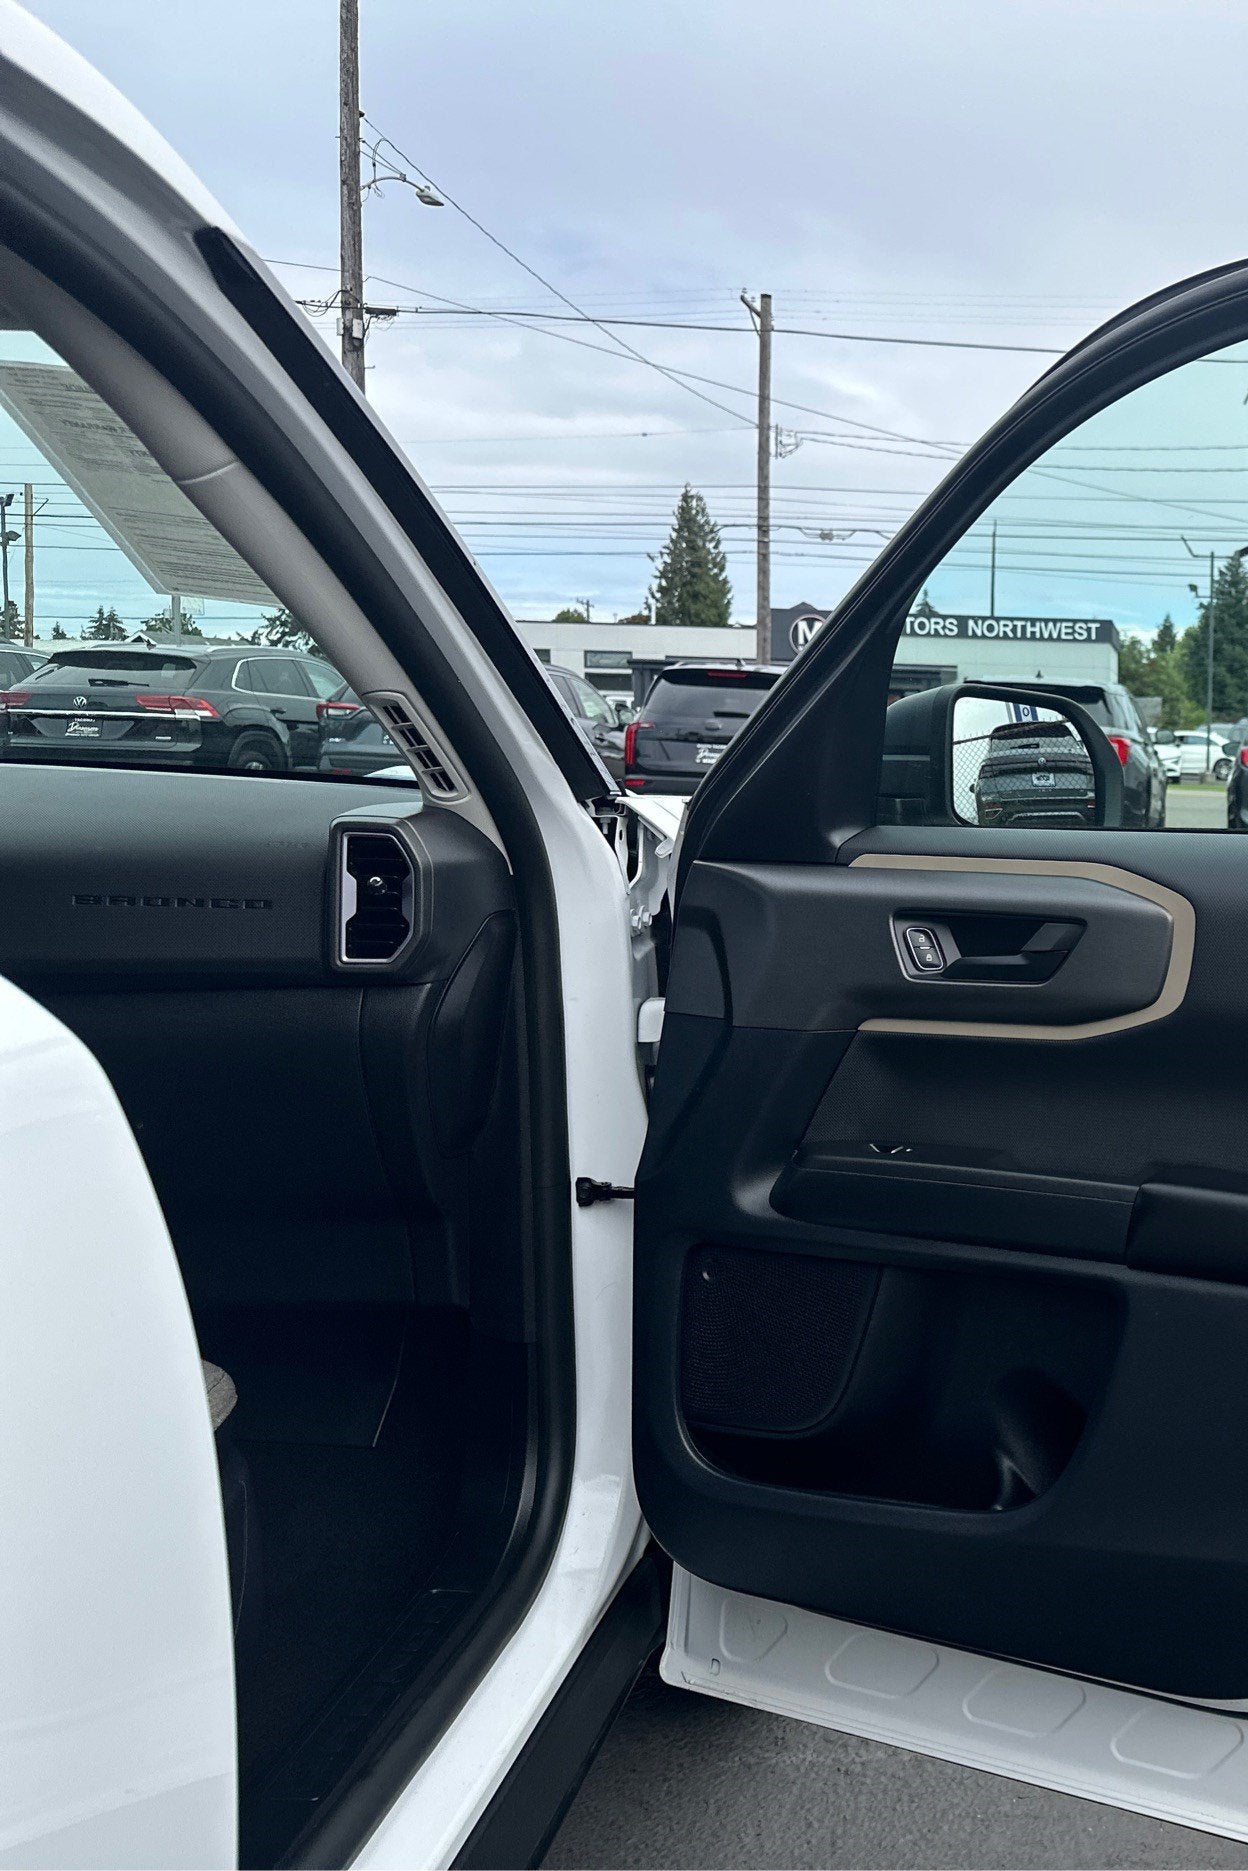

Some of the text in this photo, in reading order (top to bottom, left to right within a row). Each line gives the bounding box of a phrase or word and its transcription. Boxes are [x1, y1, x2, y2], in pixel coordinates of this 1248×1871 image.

[905, 616, 1101, 641] TORS NORTHWEST
[71, 894, 274, 909] BRONCO
